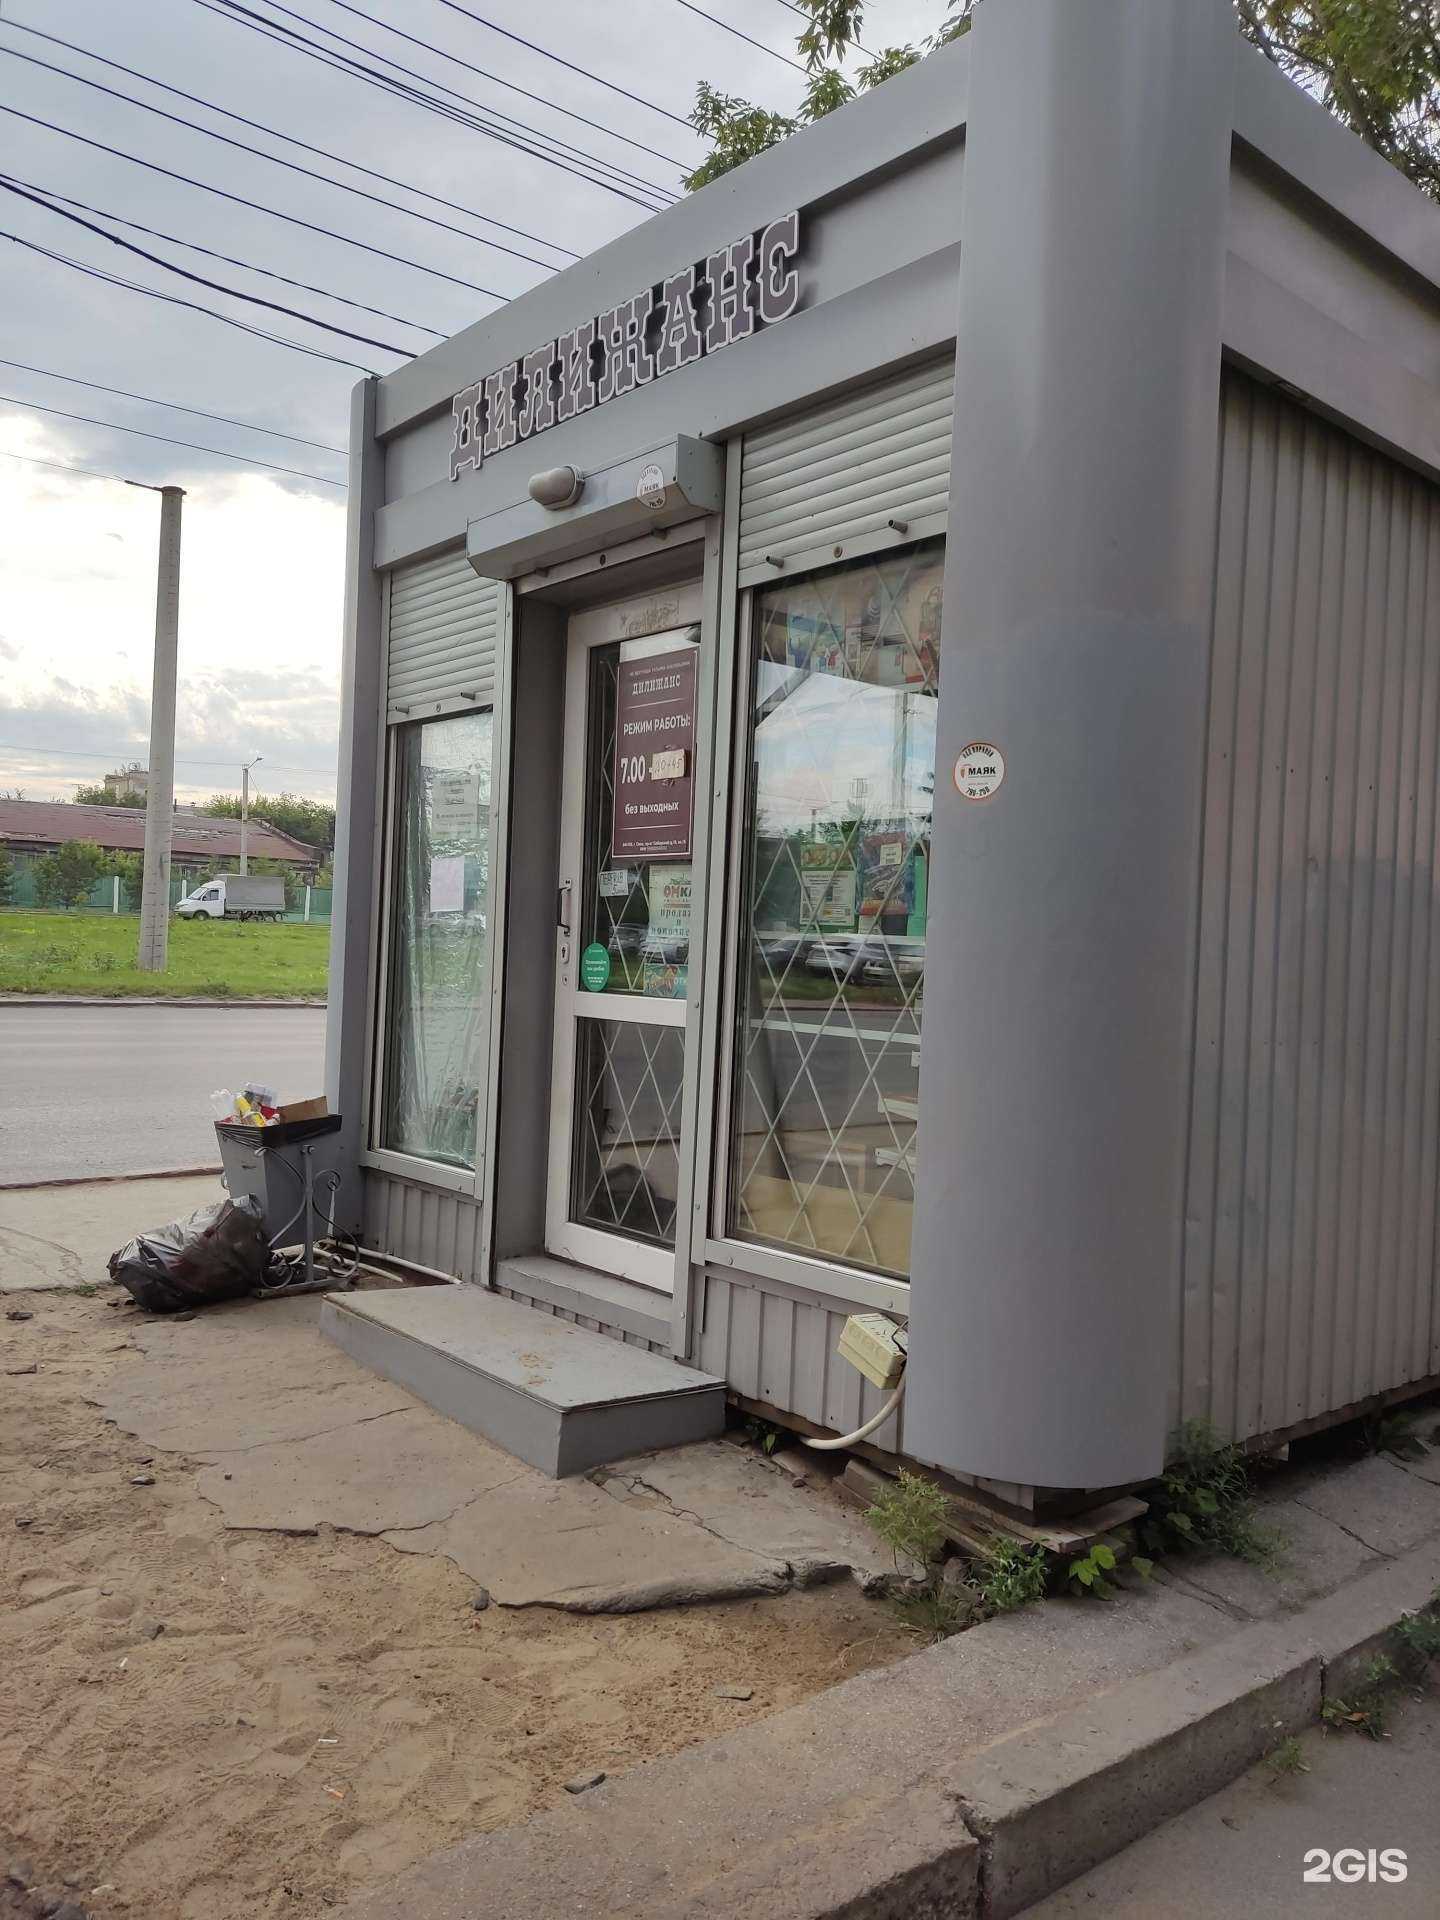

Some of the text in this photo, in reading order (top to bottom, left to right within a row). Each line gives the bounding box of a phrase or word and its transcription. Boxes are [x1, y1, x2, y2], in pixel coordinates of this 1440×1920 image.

[448, 210, 800, 482] ДИЛИЖАНС
[632, 674, 681, 695] ДИЛИЖАНС
[623, 713, 691, 736] РЕЖИМ РАБОТЫ:
[620, 754, 646, 785] 7.00
[968, 766, 996, 775] МАЯК
[624, 801, 679, 815] без выходных
